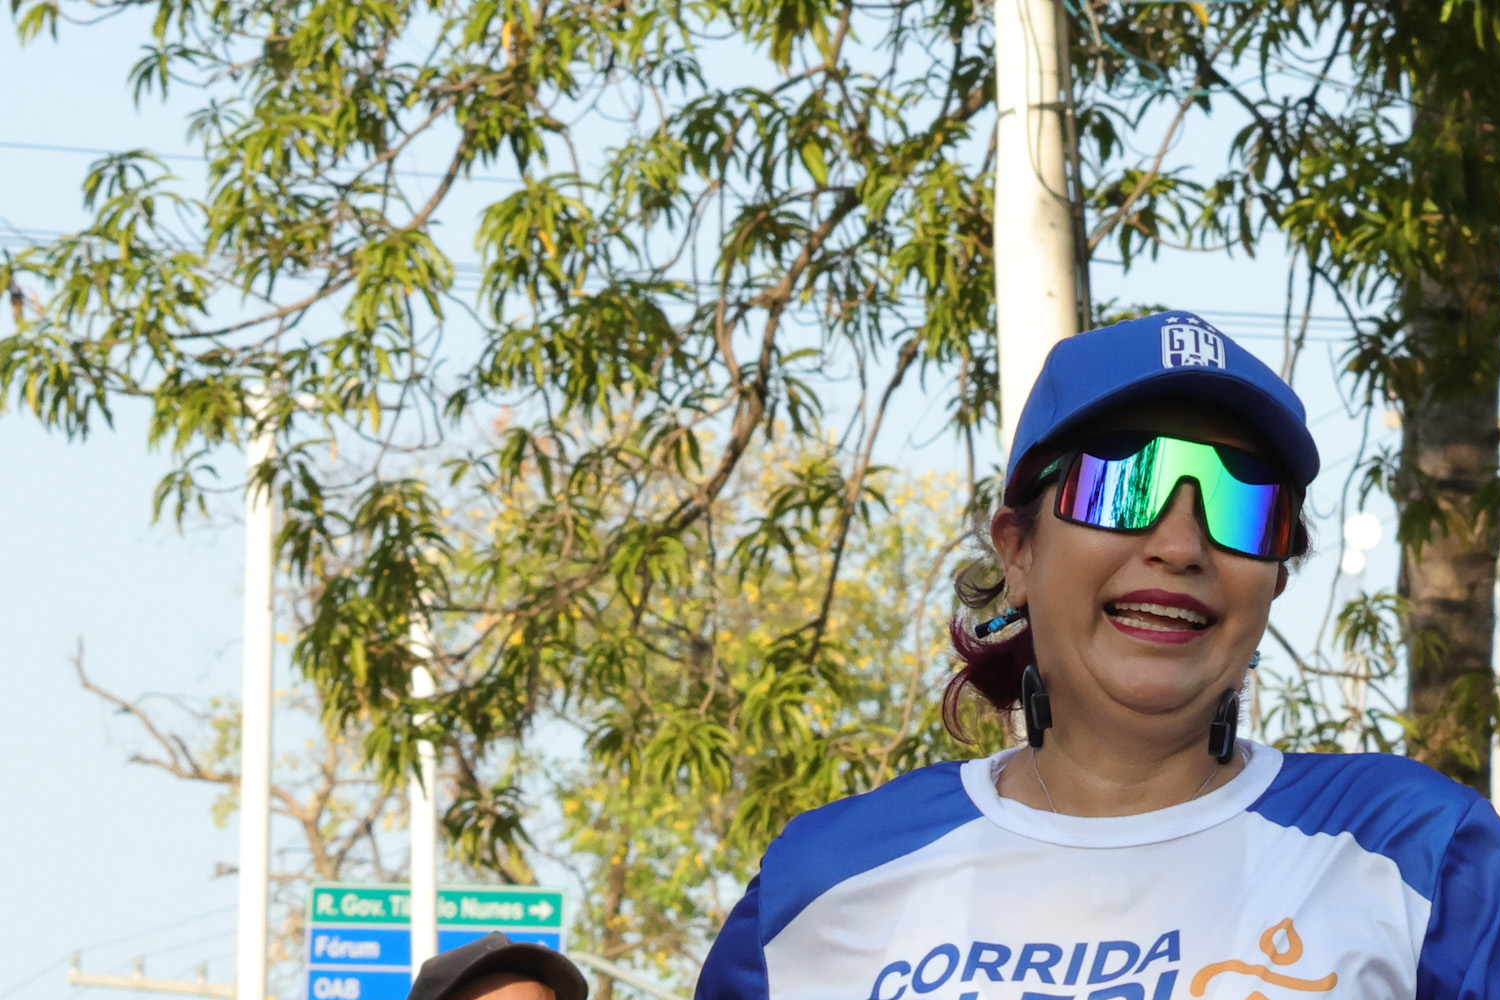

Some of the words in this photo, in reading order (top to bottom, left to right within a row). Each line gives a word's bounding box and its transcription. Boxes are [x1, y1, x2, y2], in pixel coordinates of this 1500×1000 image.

[460, 896, 525, 921] Nunes
[314, 935, 381, 959] Fórum
[867, 929, 1180, 1000] CORRIDA
[313, 977, 361, 1000] OAB
